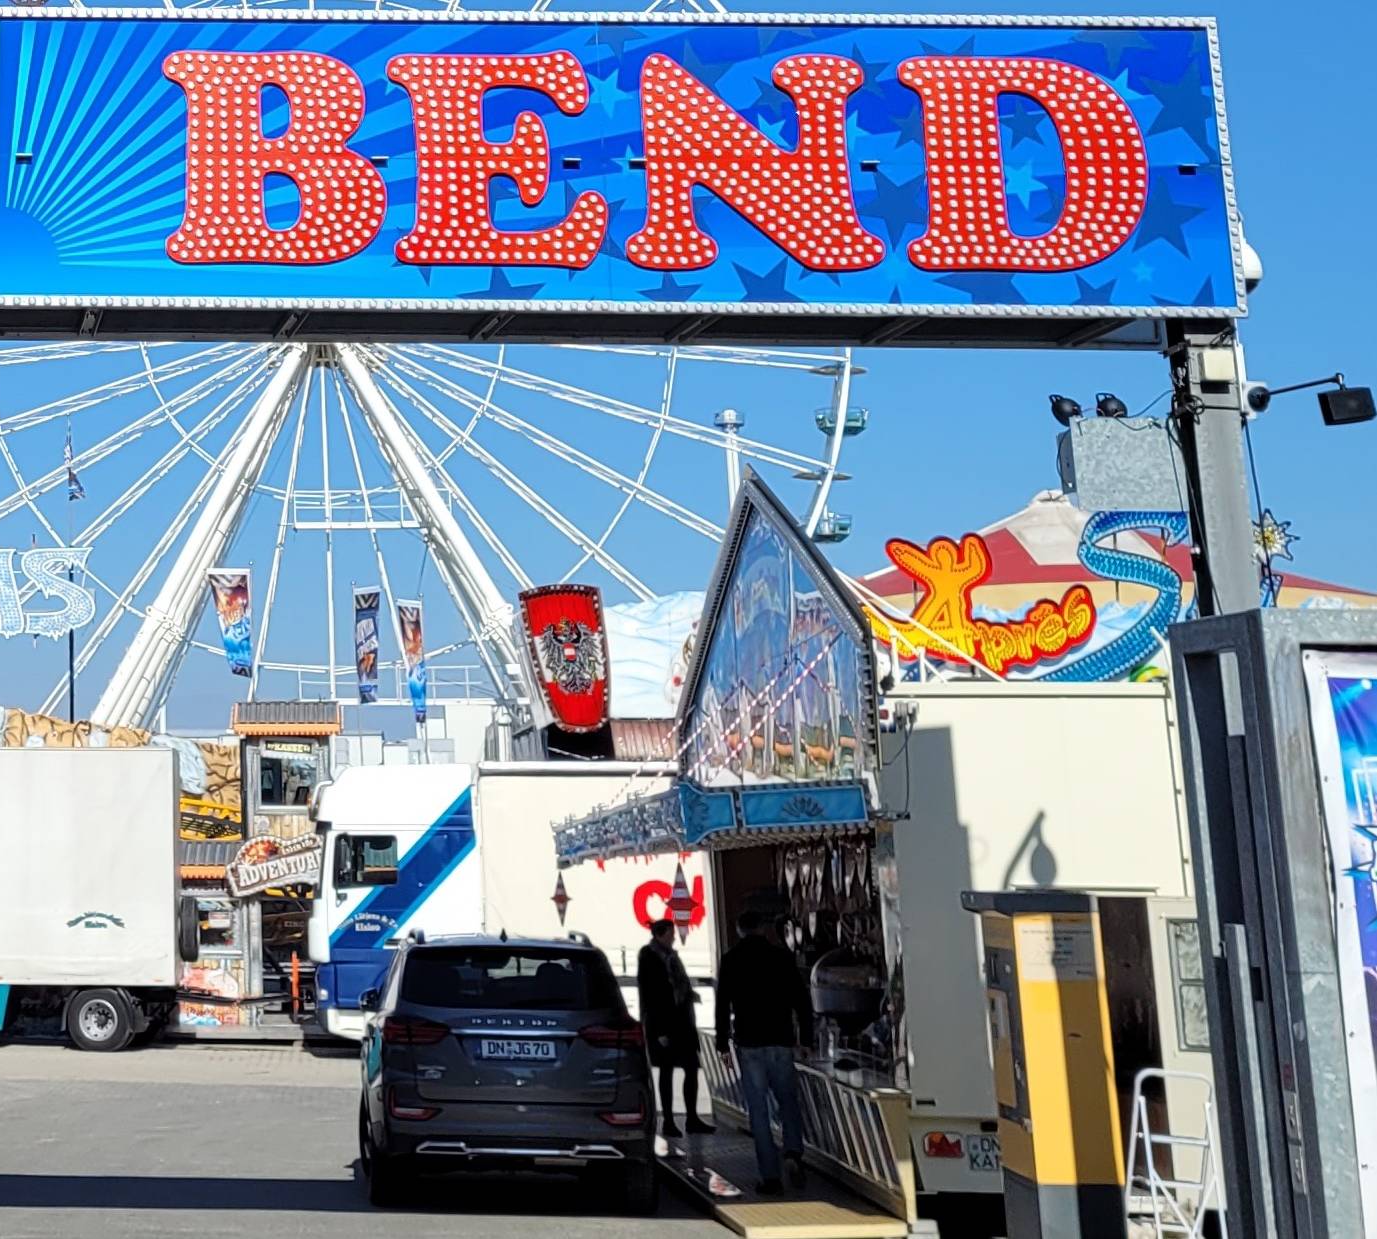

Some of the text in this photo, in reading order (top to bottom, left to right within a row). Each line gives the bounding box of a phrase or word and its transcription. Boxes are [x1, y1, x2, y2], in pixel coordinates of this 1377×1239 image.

[163, 50, 1150, 275] BEND
[487, 1041, 550, 1056] DN JG 70
